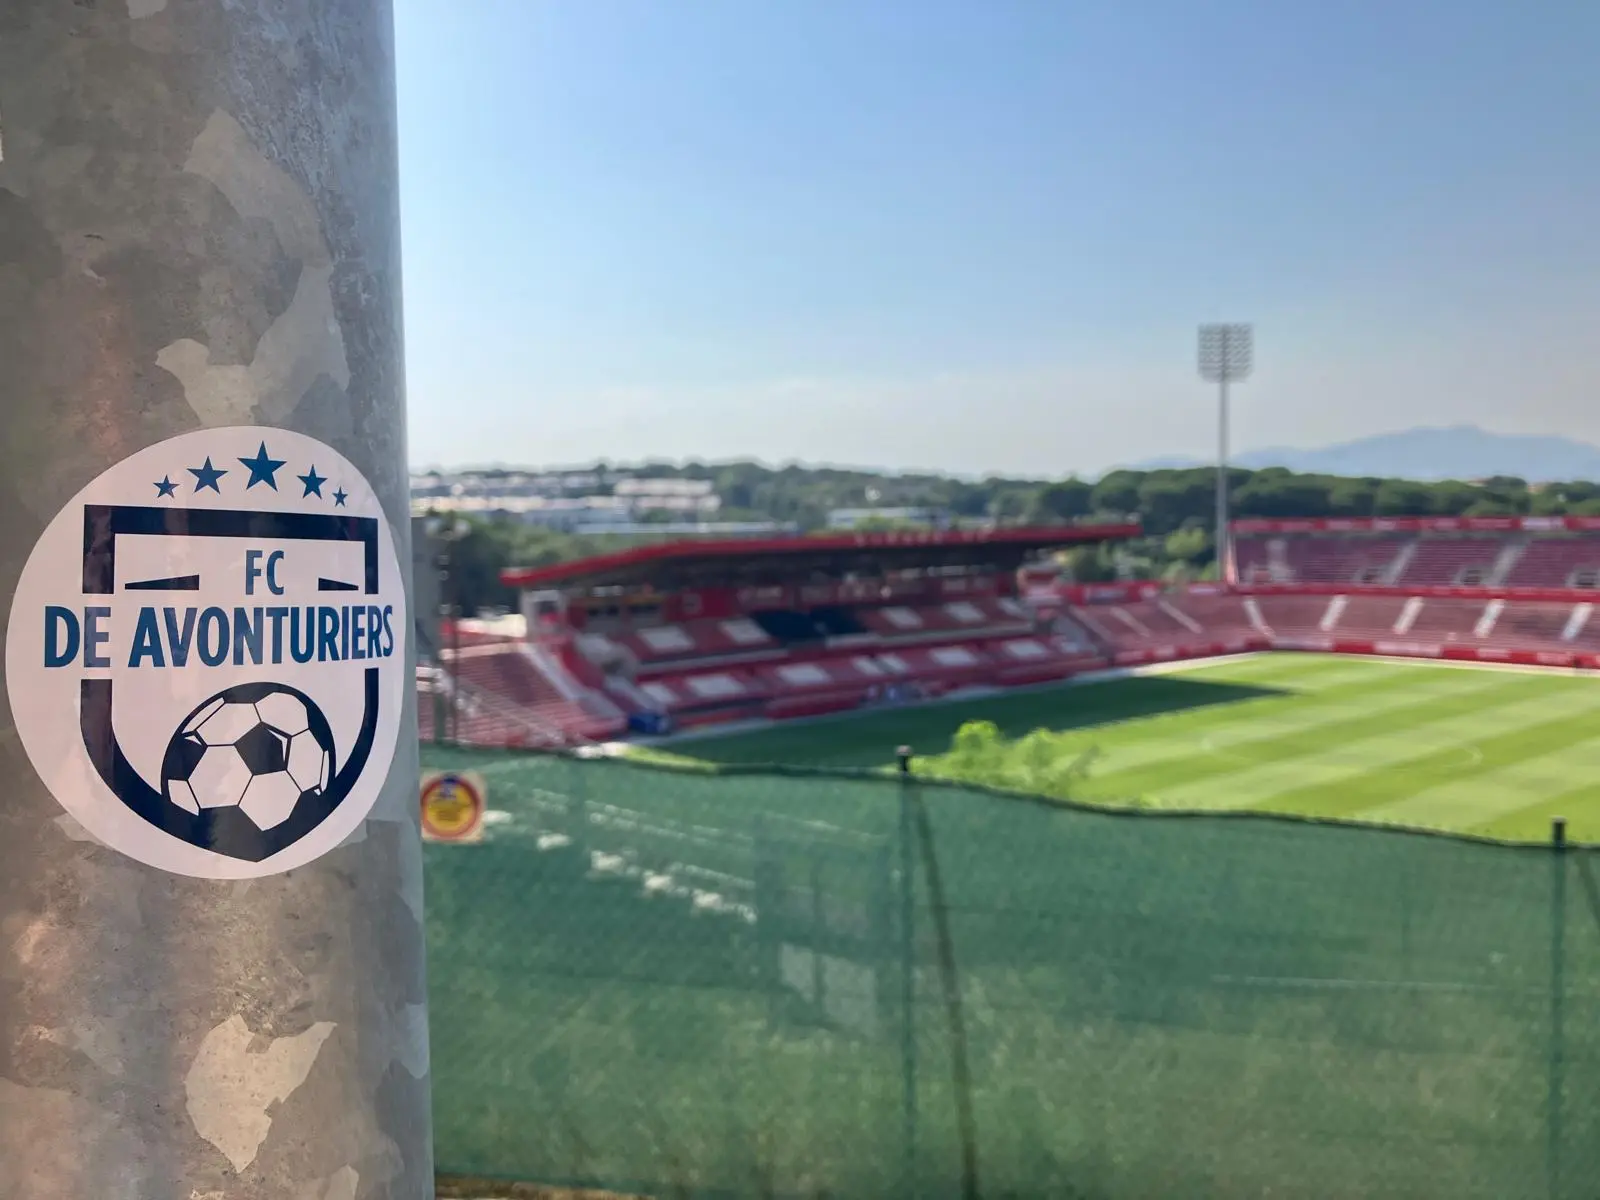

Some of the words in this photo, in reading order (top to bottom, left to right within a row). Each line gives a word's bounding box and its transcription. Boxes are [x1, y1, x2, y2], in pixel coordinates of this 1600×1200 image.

[245, 550, 284, 595] FC
[44, 605, 111, 668] DE
[128, 605, 393, 668] AVONTURIERS
